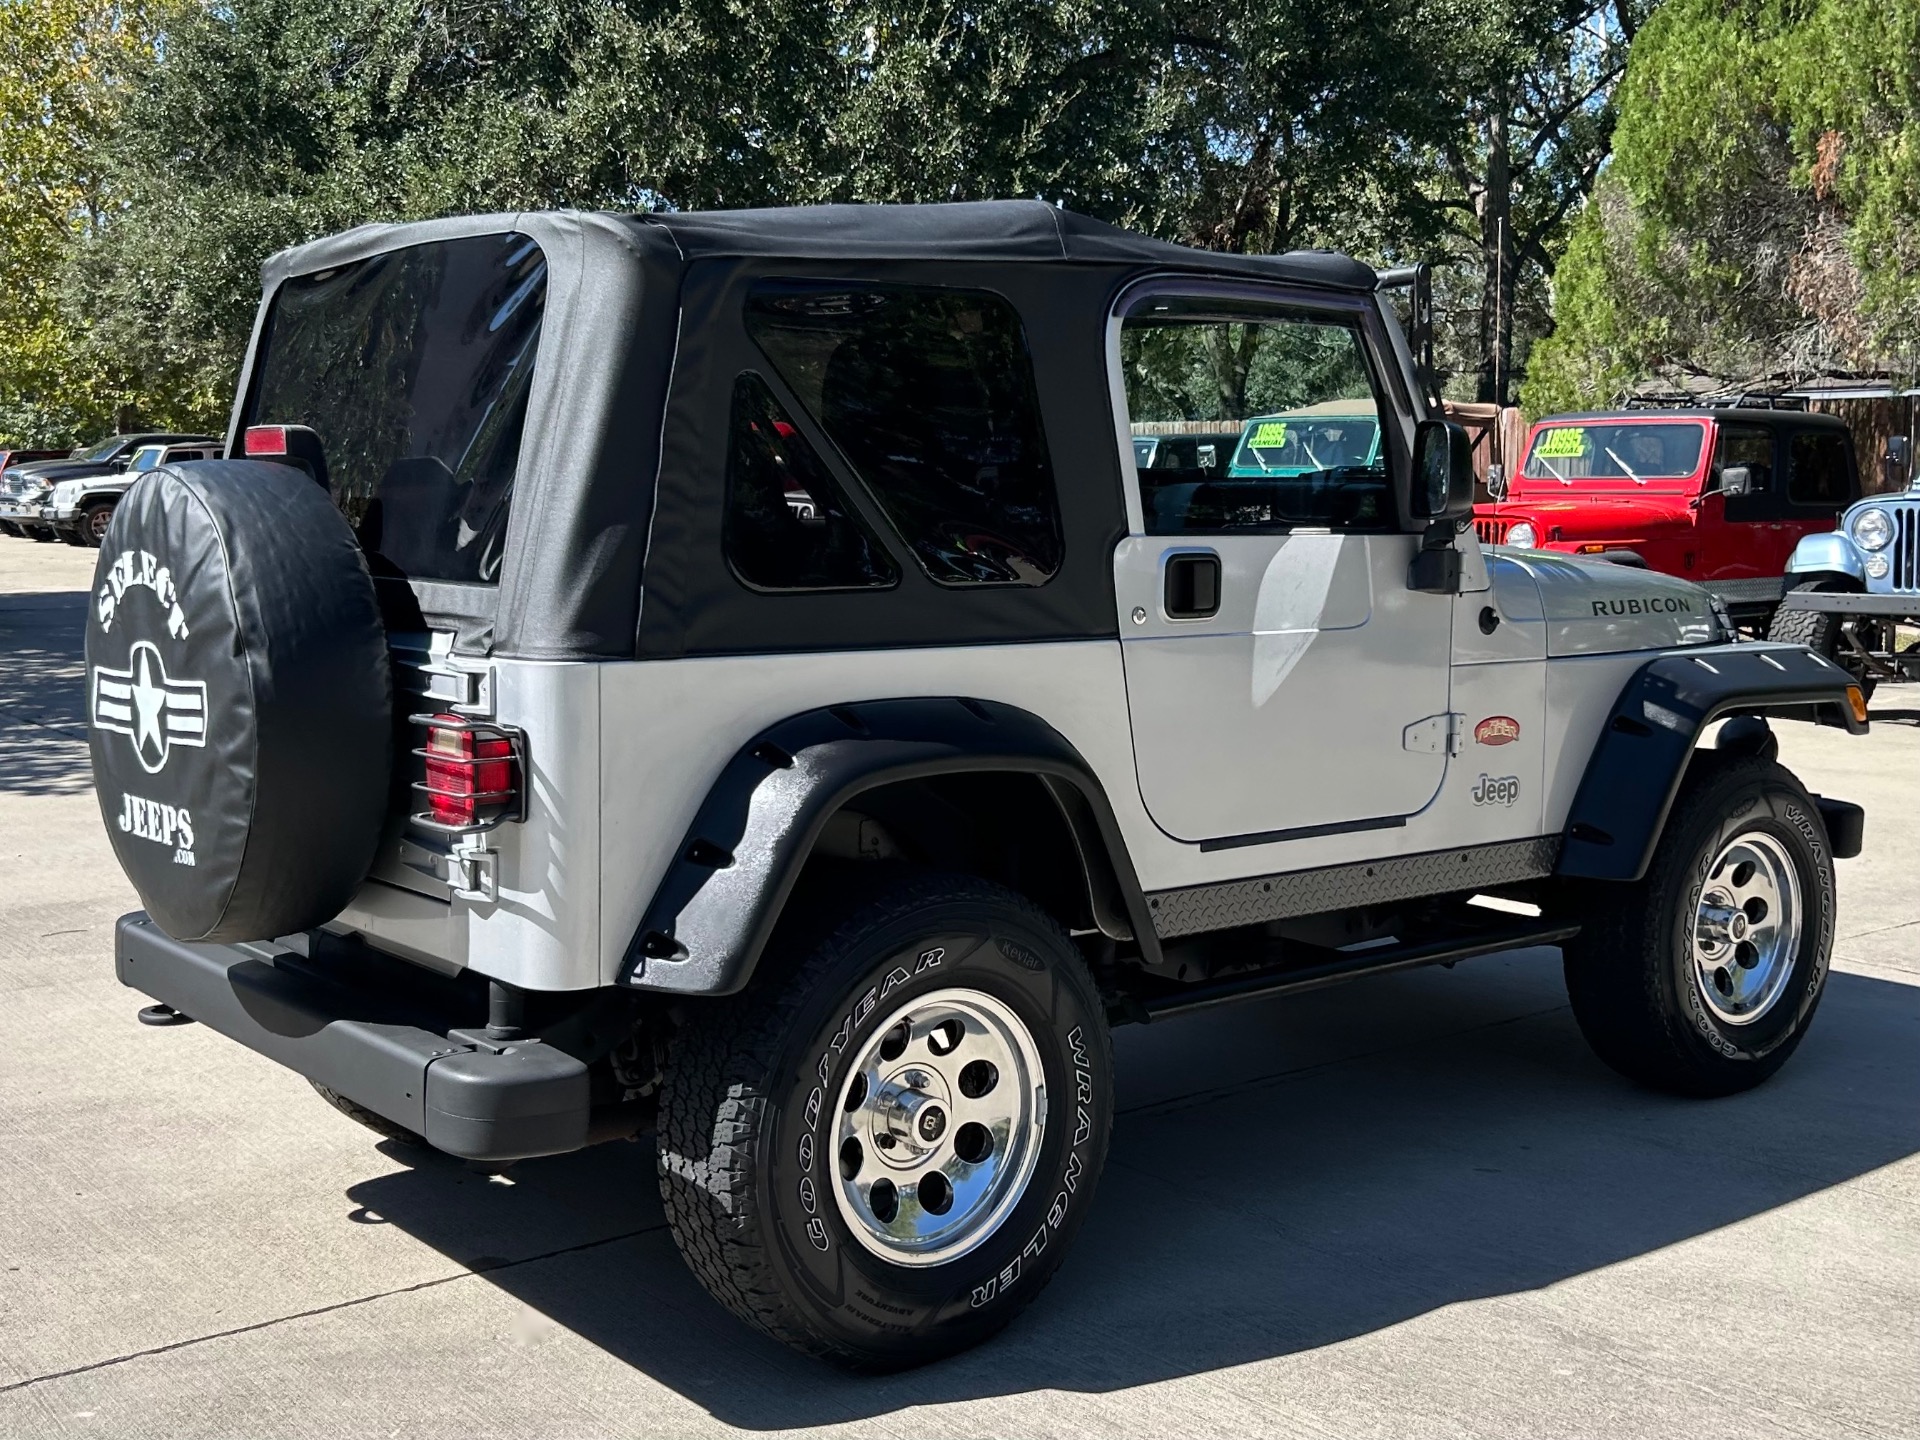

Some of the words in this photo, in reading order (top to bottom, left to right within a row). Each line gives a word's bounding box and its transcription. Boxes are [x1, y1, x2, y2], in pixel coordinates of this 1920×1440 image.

[1538, 447, 1580, 455] MANUAL
[1592, 598, 1690, 616] RUBICON
[1473, 776, 1519, 804] Jeep
[118, 792, 194, 850] JEEPS
[1786, 804, 1831, 998] WRANGLER
[1001, 940, 1039, 969] Kevlar
[799, 947, 945, 1253] GOODYEAR
[970, 1026, 1093, 1309] WRANGLER
[854, 1288, 915, 1317] ADVENTURE
